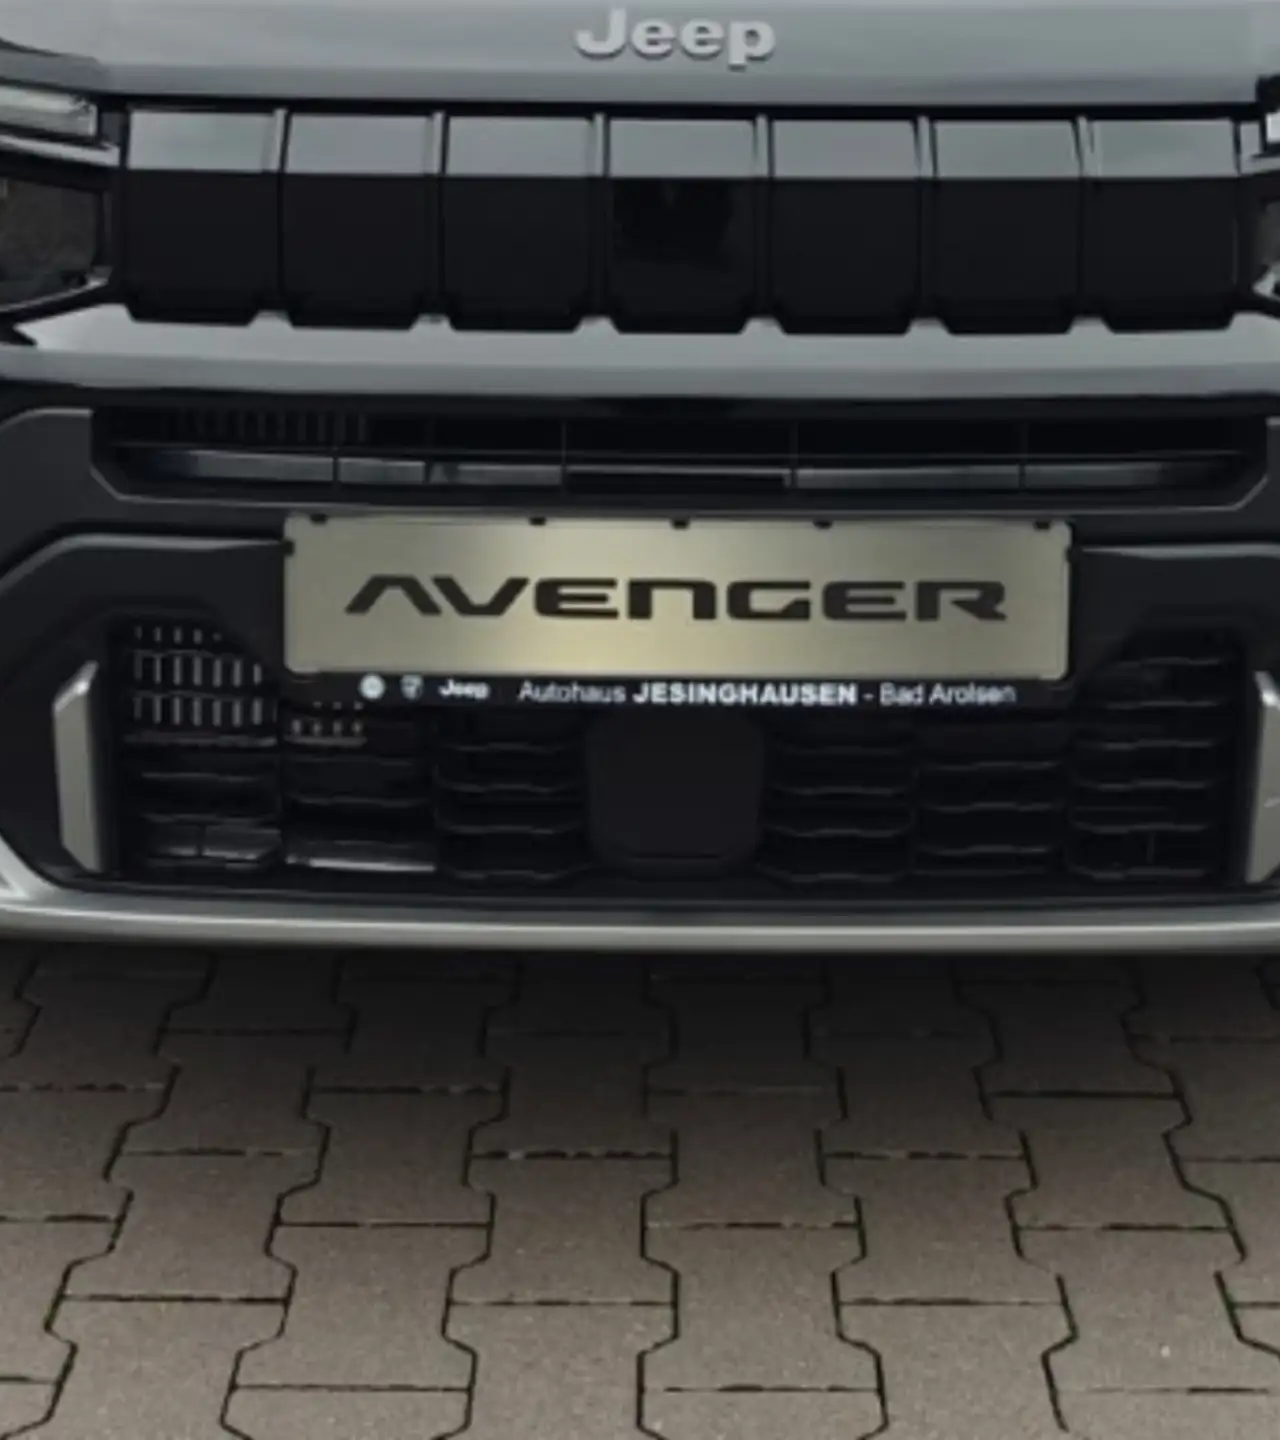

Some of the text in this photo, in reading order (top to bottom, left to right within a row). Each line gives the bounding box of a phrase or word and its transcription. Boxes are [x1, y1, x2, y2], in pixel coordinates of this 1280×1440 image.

[574, 7, 777, 69] Jeep
[344, 574, 1008, 622] AVENGER
[438, 678, 491, 700] Jeep
[517, 679, 627, 704] Autohaus
[631, 681, 859, 706] JESINGHAUSEN
[879, 682, 924, 706] Bad
[928, 681, 1017, 706] Arolsen
